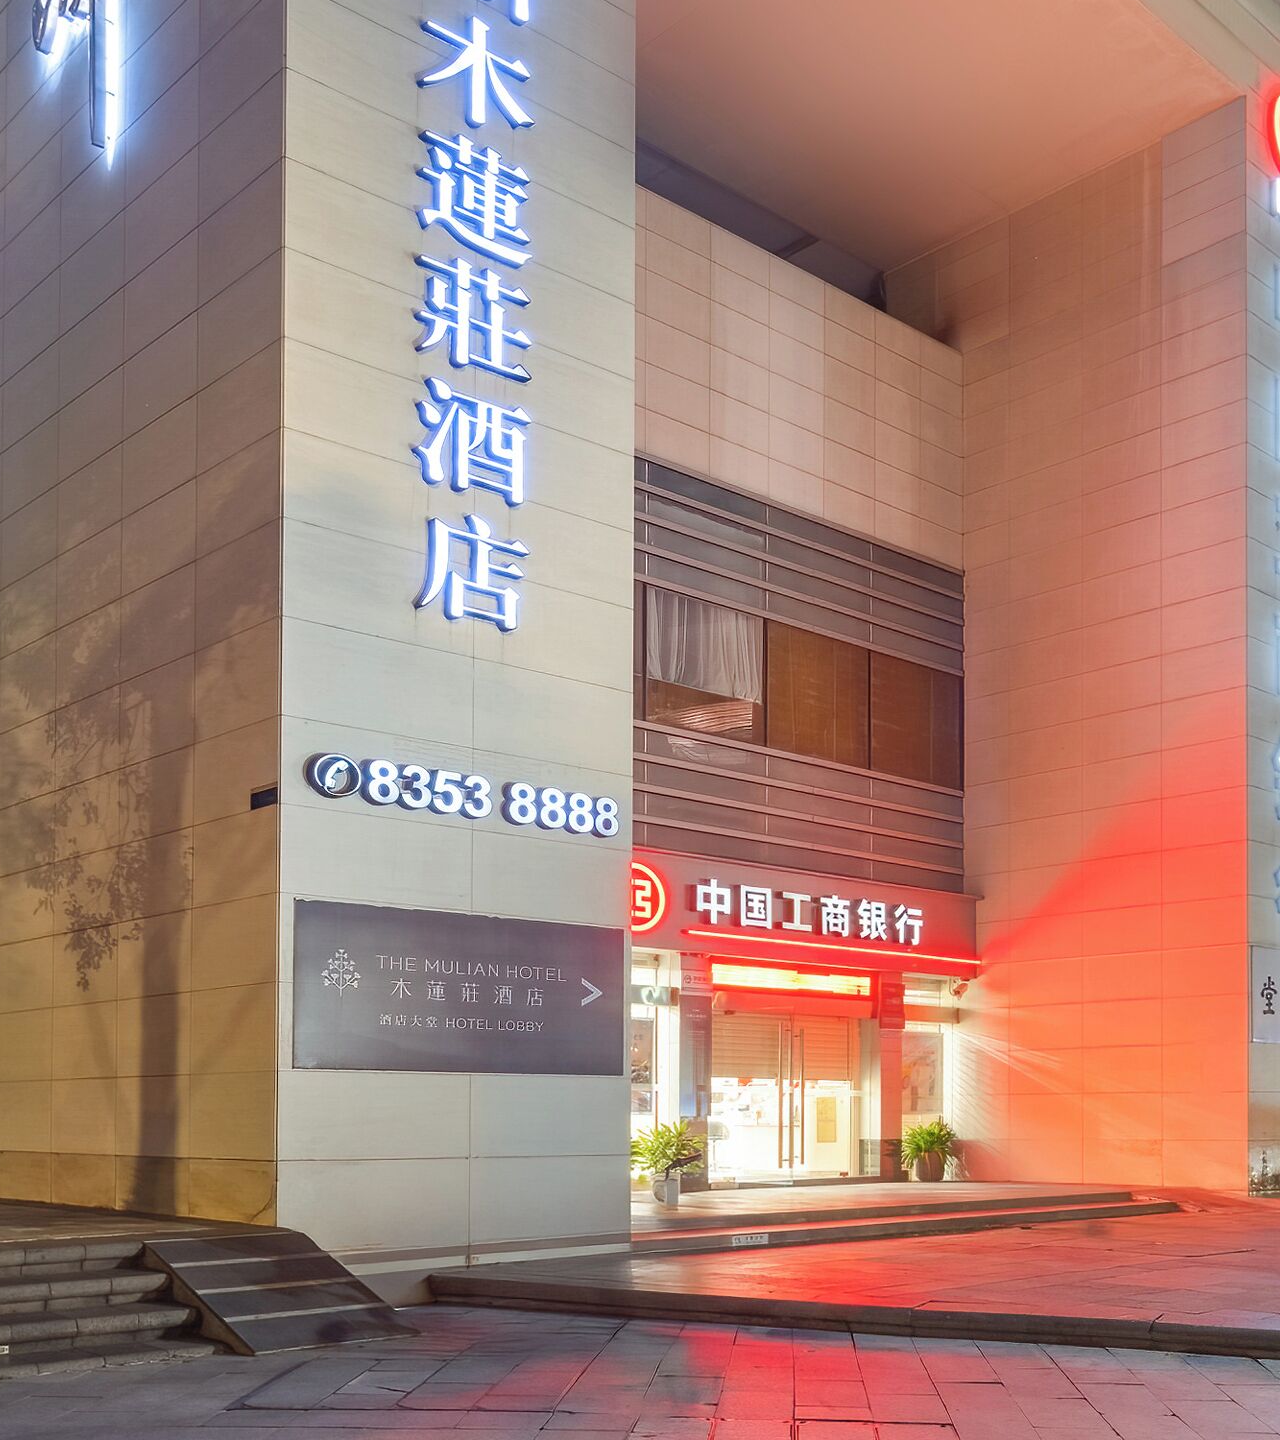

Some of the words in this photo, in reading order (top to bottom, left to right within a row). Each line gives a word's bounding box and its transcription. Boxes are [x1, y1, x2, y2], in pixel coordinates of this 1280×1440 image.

[365, 759, 493, 819] 8353
[504, 782, 619, 837] 8888
[694, 878, 924, 946] 中国工商银行
[375, 954, 417, 972] THE
[424, 958, 500, 977] MULIAN
[506, 964, 567, 983] HOTEL
[390, 977, 545, 1007] 木蓮莊酒店
[445, 1016, 493, 1030] HOTEL
[498, 1018, 545, 1032] LOBBY
